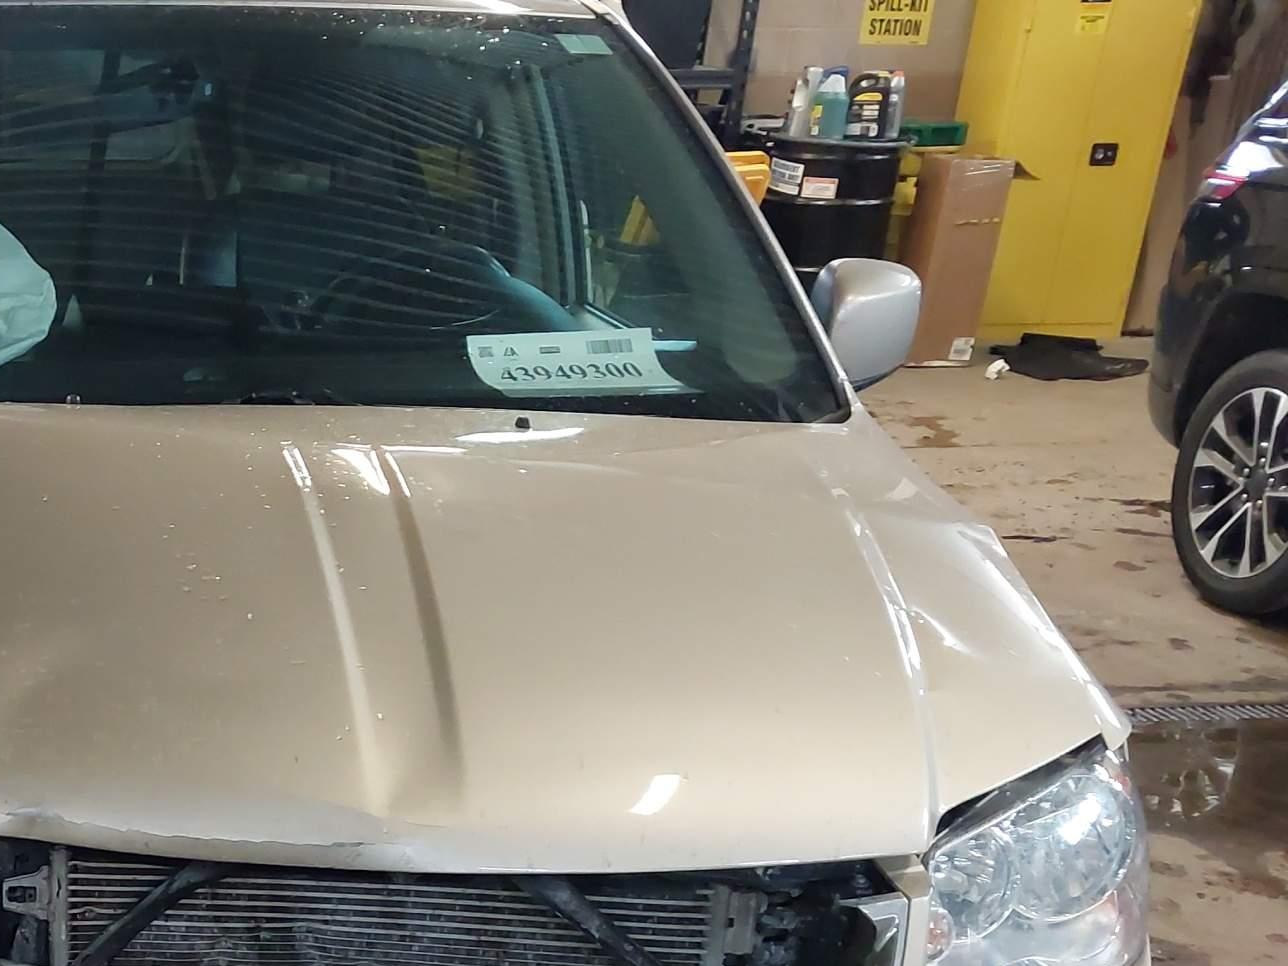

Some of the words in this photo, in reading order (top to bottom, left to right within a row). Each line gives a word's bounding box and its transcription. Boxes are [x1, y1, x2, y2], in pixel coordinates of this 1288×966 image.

[868, 0, 929, 12] SPILL-KIT
[868, 18, 923, 36] STATION
[500, 361, 644, 382] 43949300
